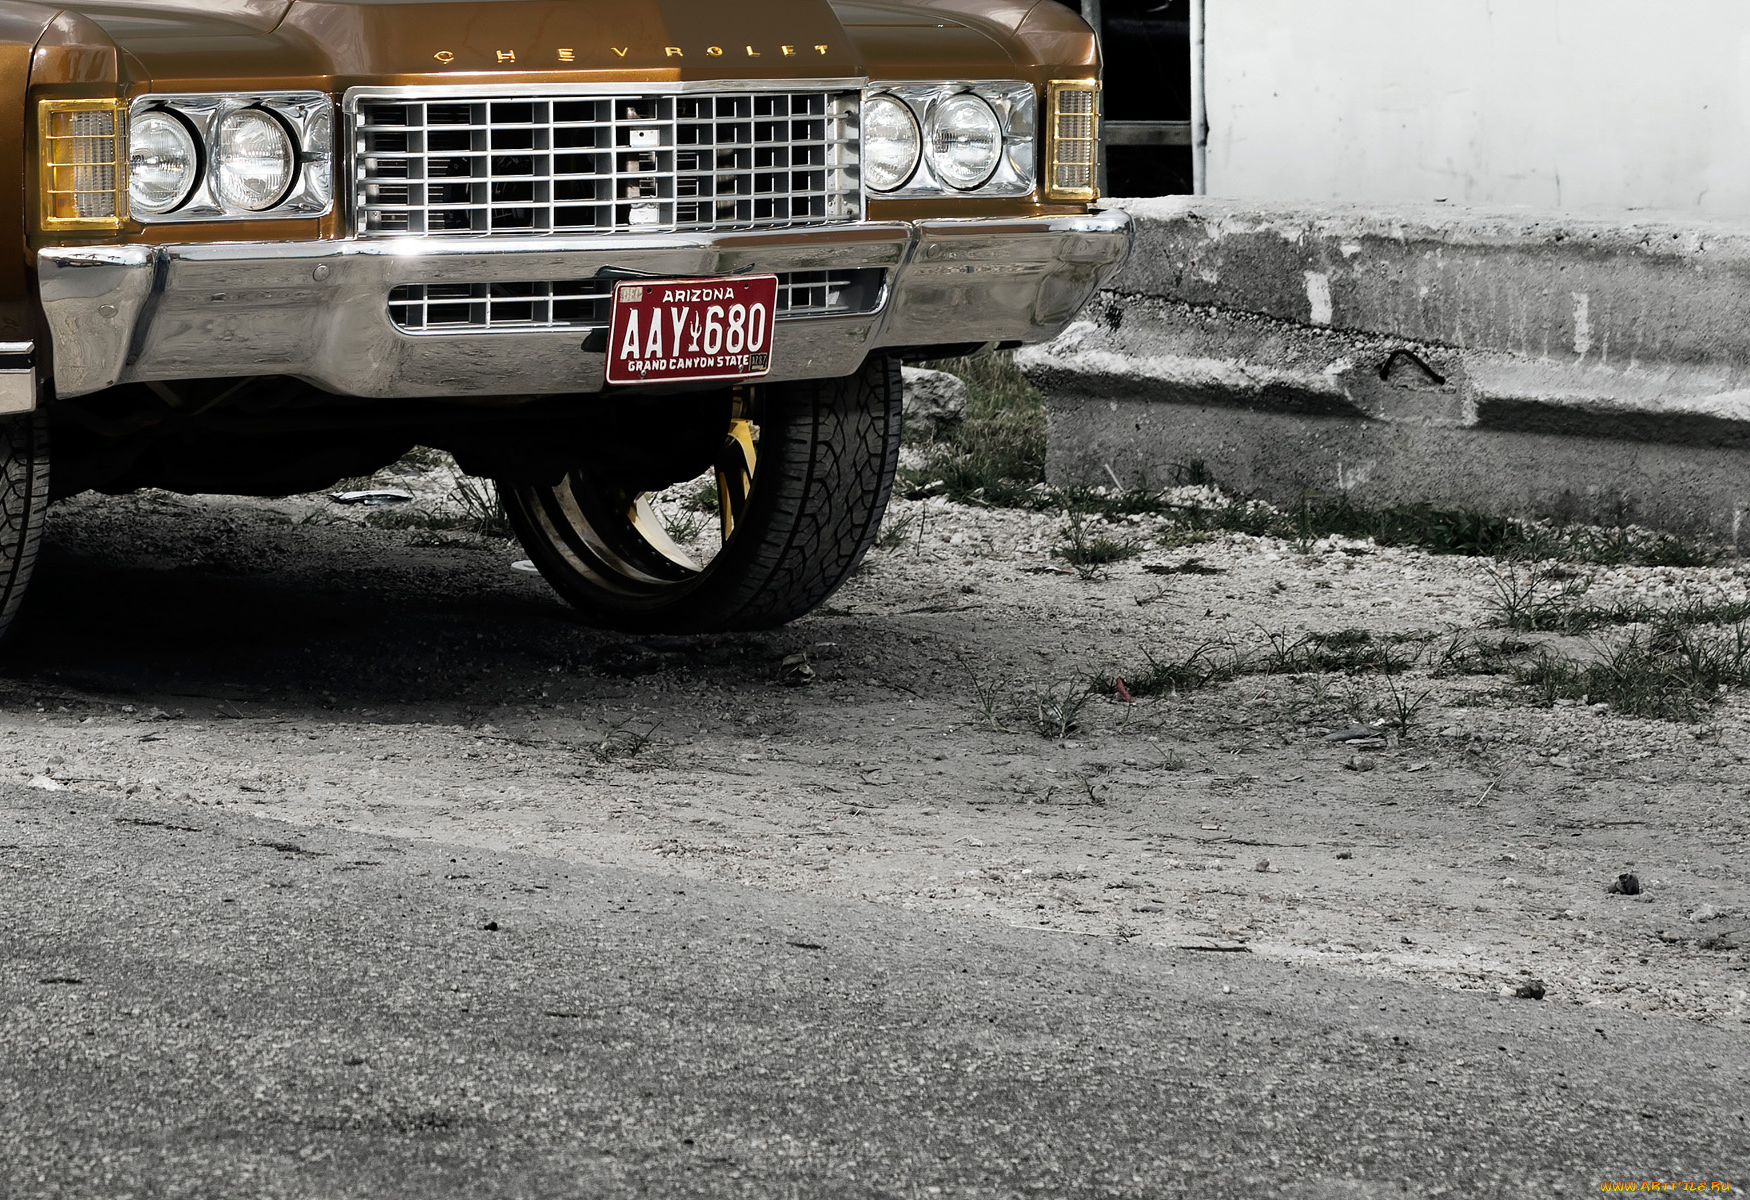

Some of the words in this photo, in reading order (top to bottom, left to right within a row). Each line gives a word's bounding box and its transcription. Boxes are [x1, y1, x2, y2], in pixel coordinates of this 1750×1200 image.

[433, 44, 828, 65] CHEVROLET
[662, 287, 735, 303] ARIZONA
[620, 306, 690, 360] AAY
[703, 302, 766, 355] 680
[627, 358, 667, 373] GRAND
[669, 356, 715, 370] CANYON
[717, 354, 750, 367] STATE
